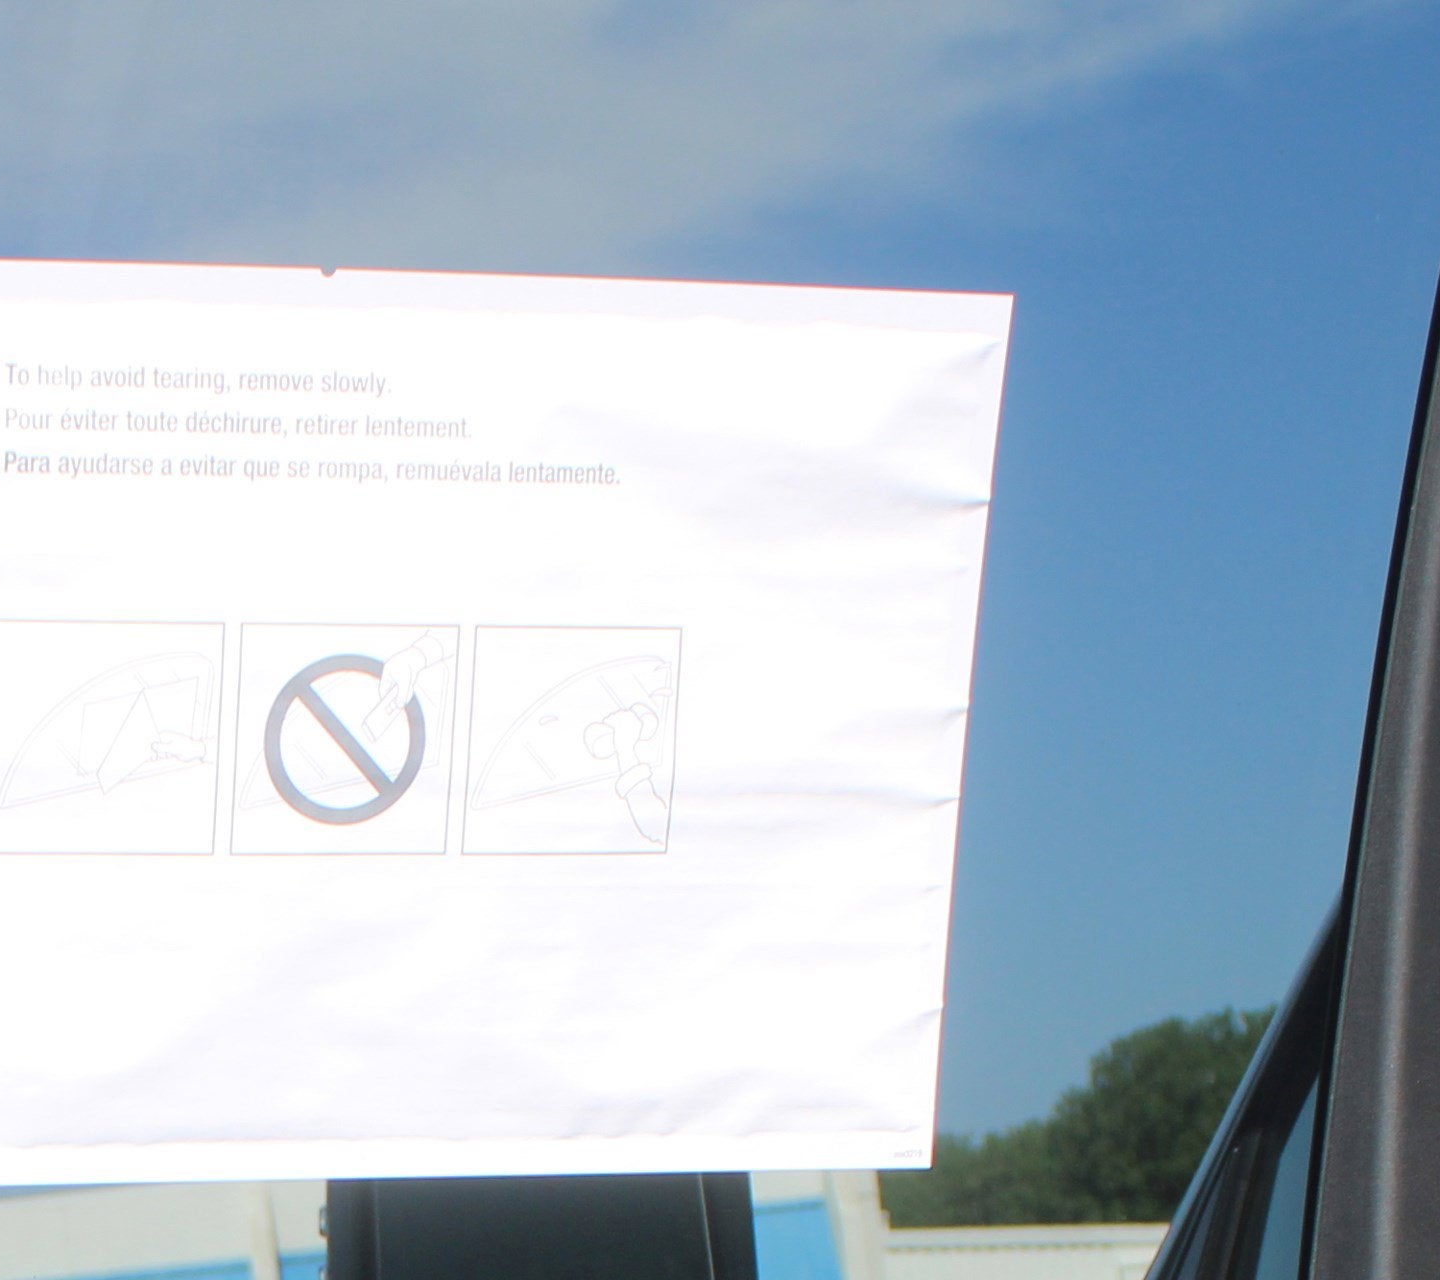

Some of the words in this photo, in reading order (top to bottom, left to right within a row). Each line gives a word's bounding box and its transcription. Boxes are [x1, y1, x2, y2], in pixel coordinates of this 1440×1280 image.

[4, 362, 30, 386] To
[37, 364, 83, 393] help
[89, 365, 146, 389] avoid
[152, 366, 231, 396] tearing,
[238, 372, 314, 393] remove
[320, 369, 392, 399] slowly.
[4, 407, 54, 431] Pour
[59, 407, 120, 432] éviter
[125, 410, 179, 433] toute
[185, 409, 288, 439] déchirure,
[295, 413, 359, 437] retirer
[364, 414, 472, 440] lentement.
[2, 450, 52, 475] Para
[57, 452, 154, 481] ayudarse
[160, 458, 174, 477] a
[179, 453, 238, 478] evitar
[242, 459, 281, 483] que
[286, 460, 311, 479] se
[317, 460, 389, 485] rompa,
[395, 459, 502, 483] remuévala
[508, 460, 621, 487] lentamente.
